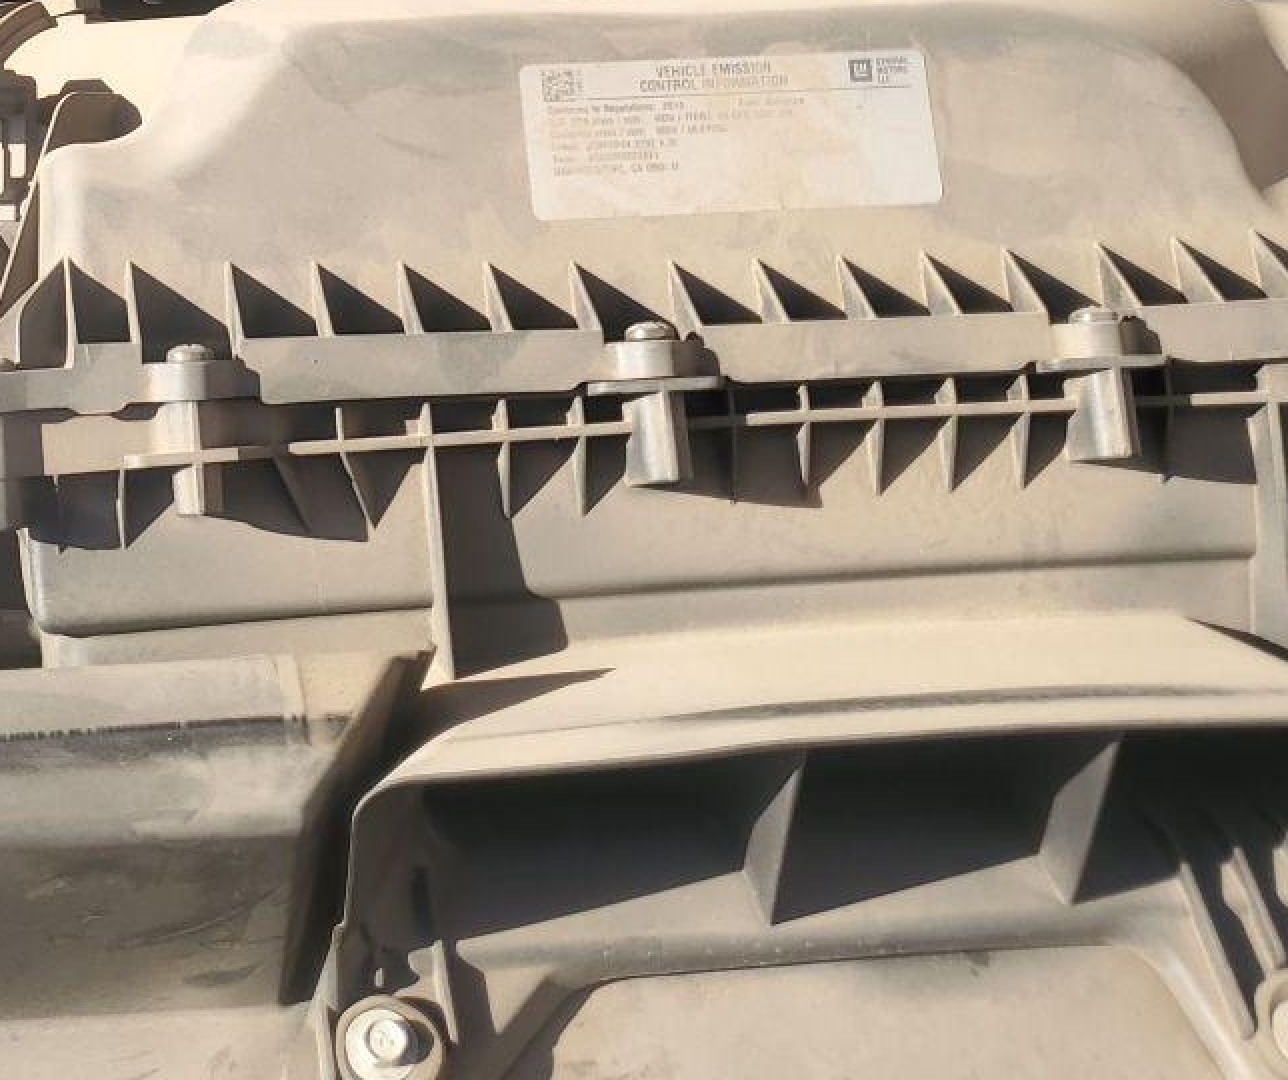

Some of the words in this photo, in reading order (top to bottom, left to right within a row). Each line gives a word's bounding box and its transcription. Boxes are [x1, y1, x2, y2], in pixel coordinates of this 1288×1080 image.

[656, 65, 704, 78] VEHICLE
[712, 60, 771, 74] EMISSION
[639, 80, 696, 92] CONTROL
[701, 75, 789, 88] INFORMATION
